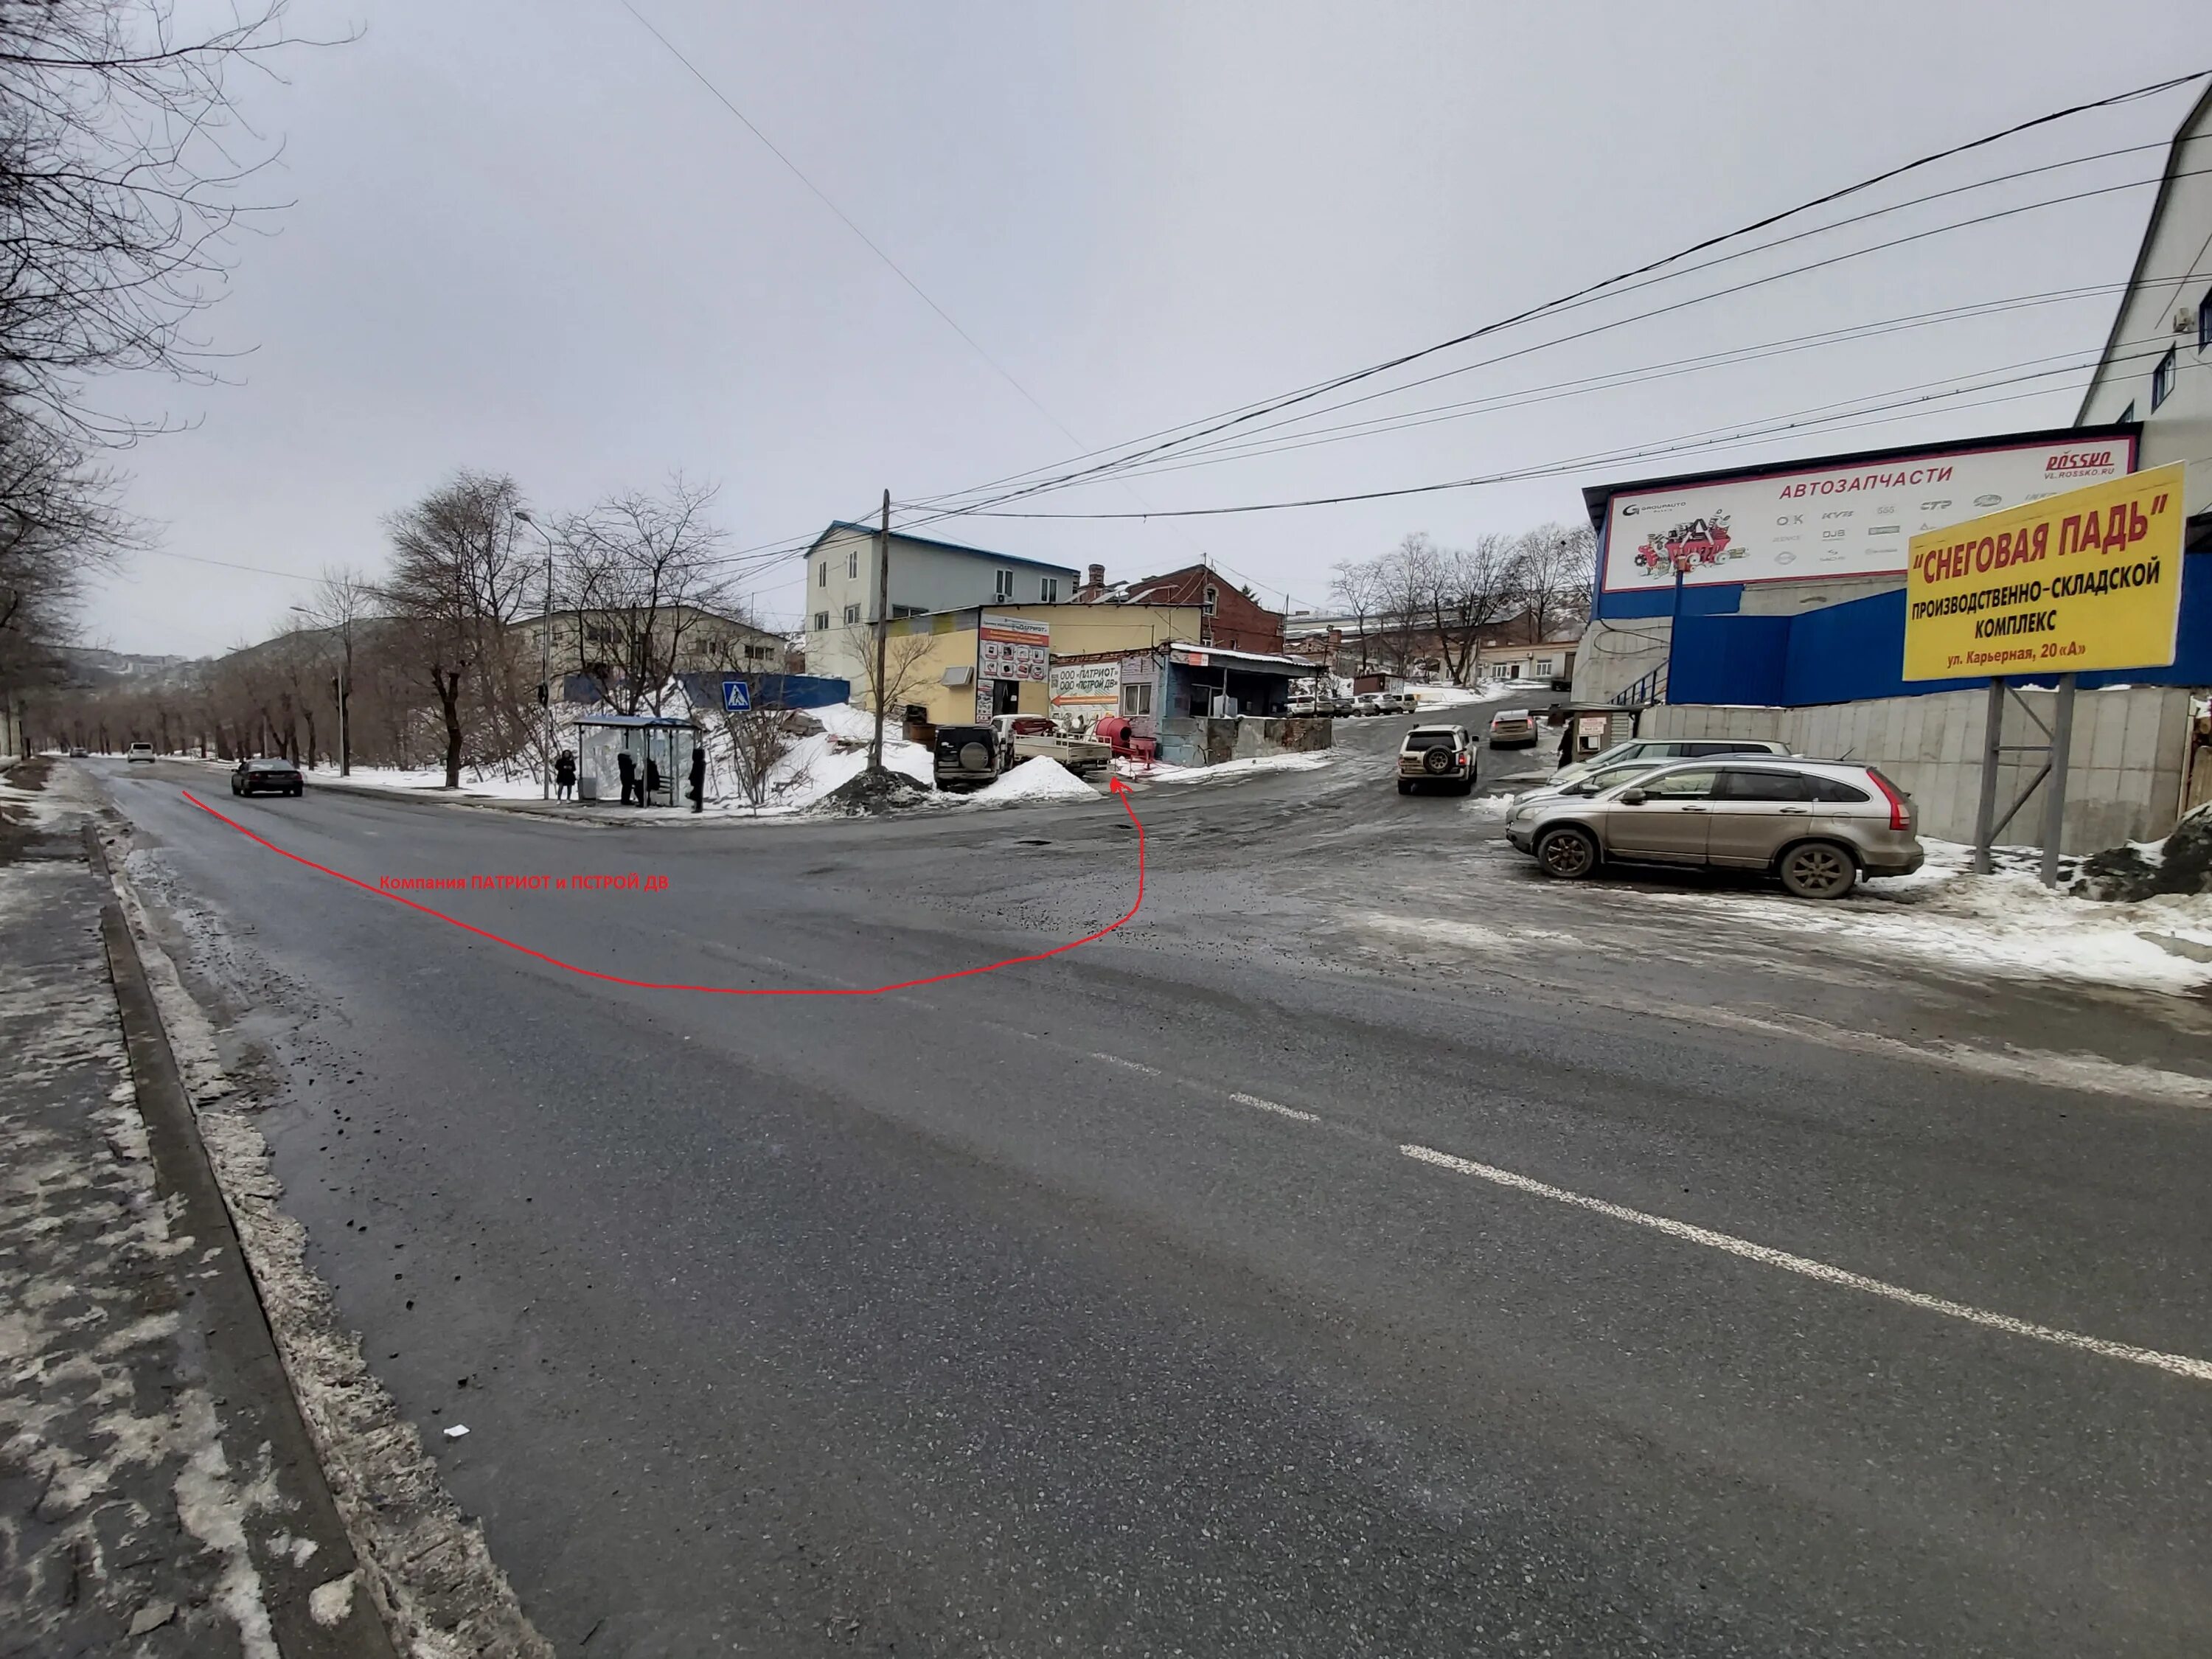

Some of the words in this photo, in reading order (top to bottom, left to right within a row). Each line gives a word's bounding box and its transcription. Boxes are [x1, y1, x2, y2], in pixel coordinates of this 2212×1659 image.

[1779, 466, 1953, 500] АВТОЗАПЧАСТИ
[2045, 468, 2115, 479] VL.ROSSKO.RU
[1912, 556, 2160, 620] ПРОИЗВОДСТВЕННО-СКЛАДСКОЙ
[1975, 610, 2057, 639] КОМПЛЕКС
[1947, 654, 1963, 669] ул.
[1966, 648, 2036, 667] Карьерная,
[1060, 670, 1075, 680] ООО
[1060, 681, 1075, 690] ООО
